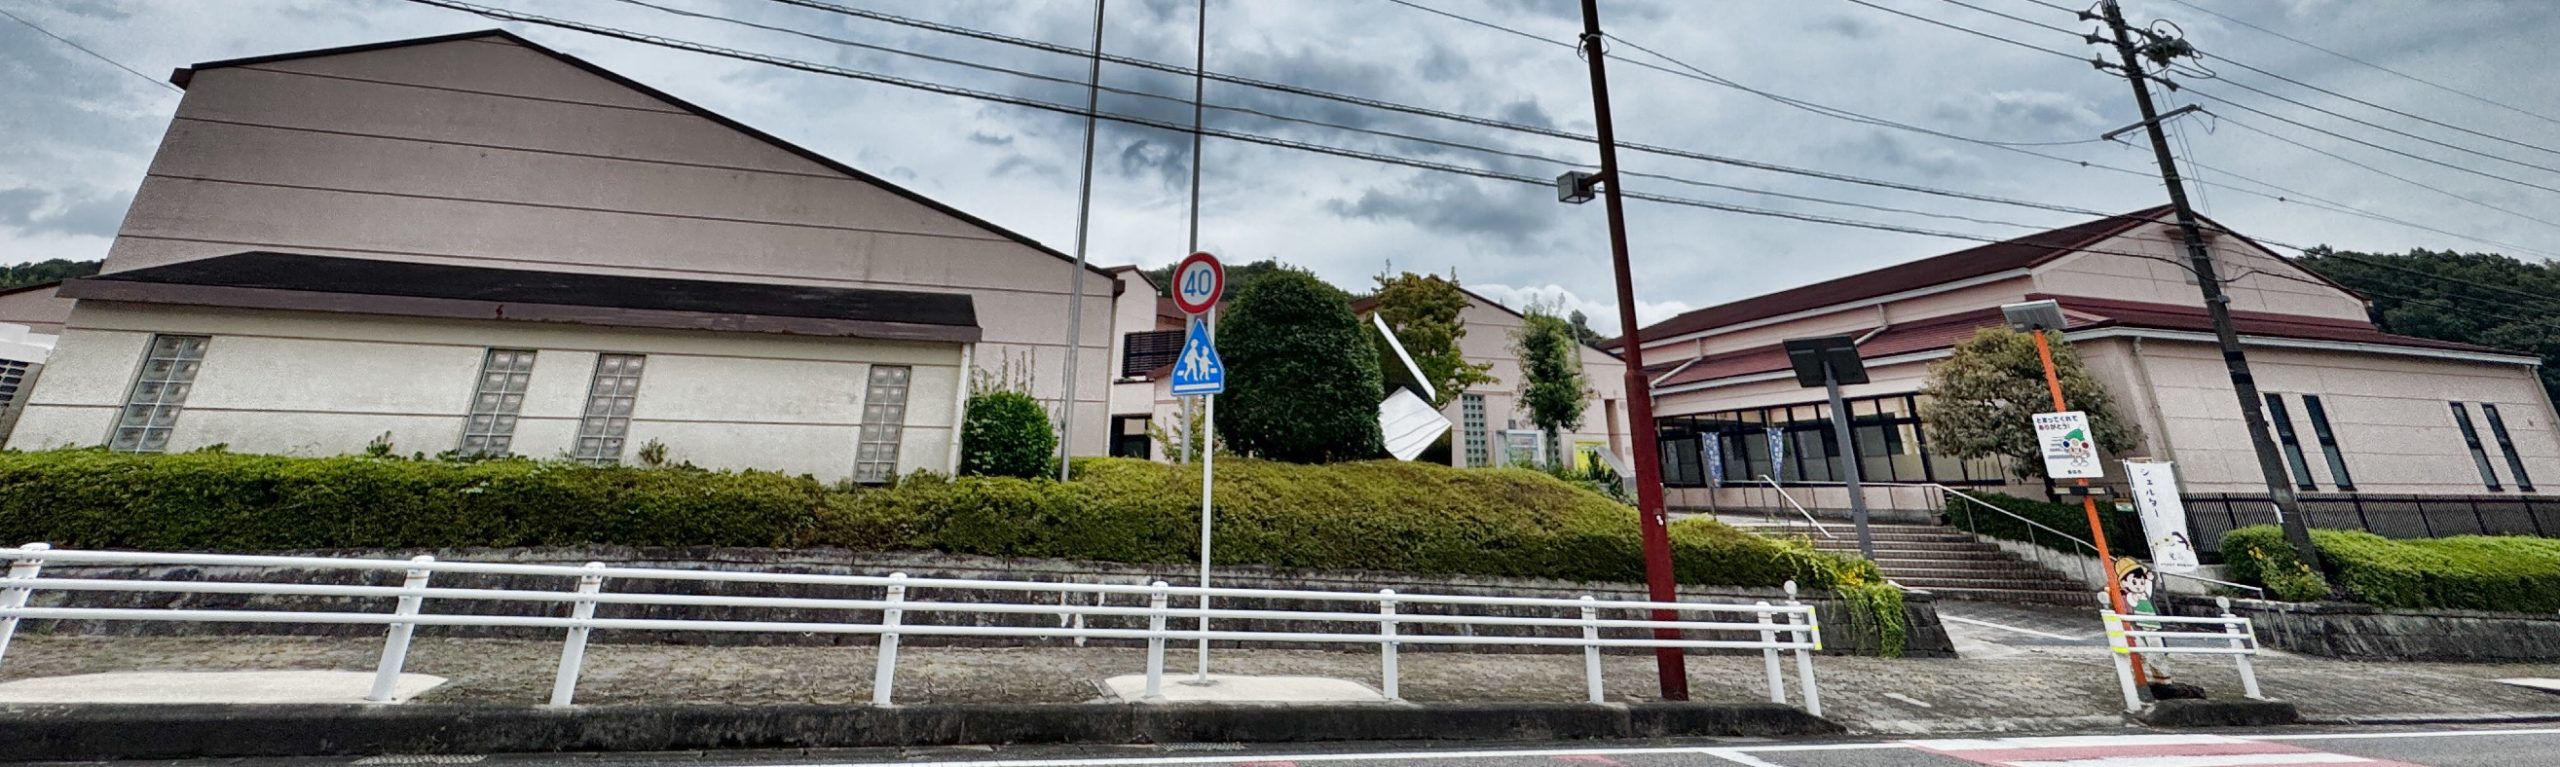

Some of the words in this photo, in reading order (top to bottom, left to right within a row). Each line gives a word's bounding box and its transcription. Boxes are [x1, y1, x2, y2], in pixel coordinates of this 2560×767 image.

[1185, 269, 1212, 296] 40
[2141, 468, 2159, 517] シェルター
